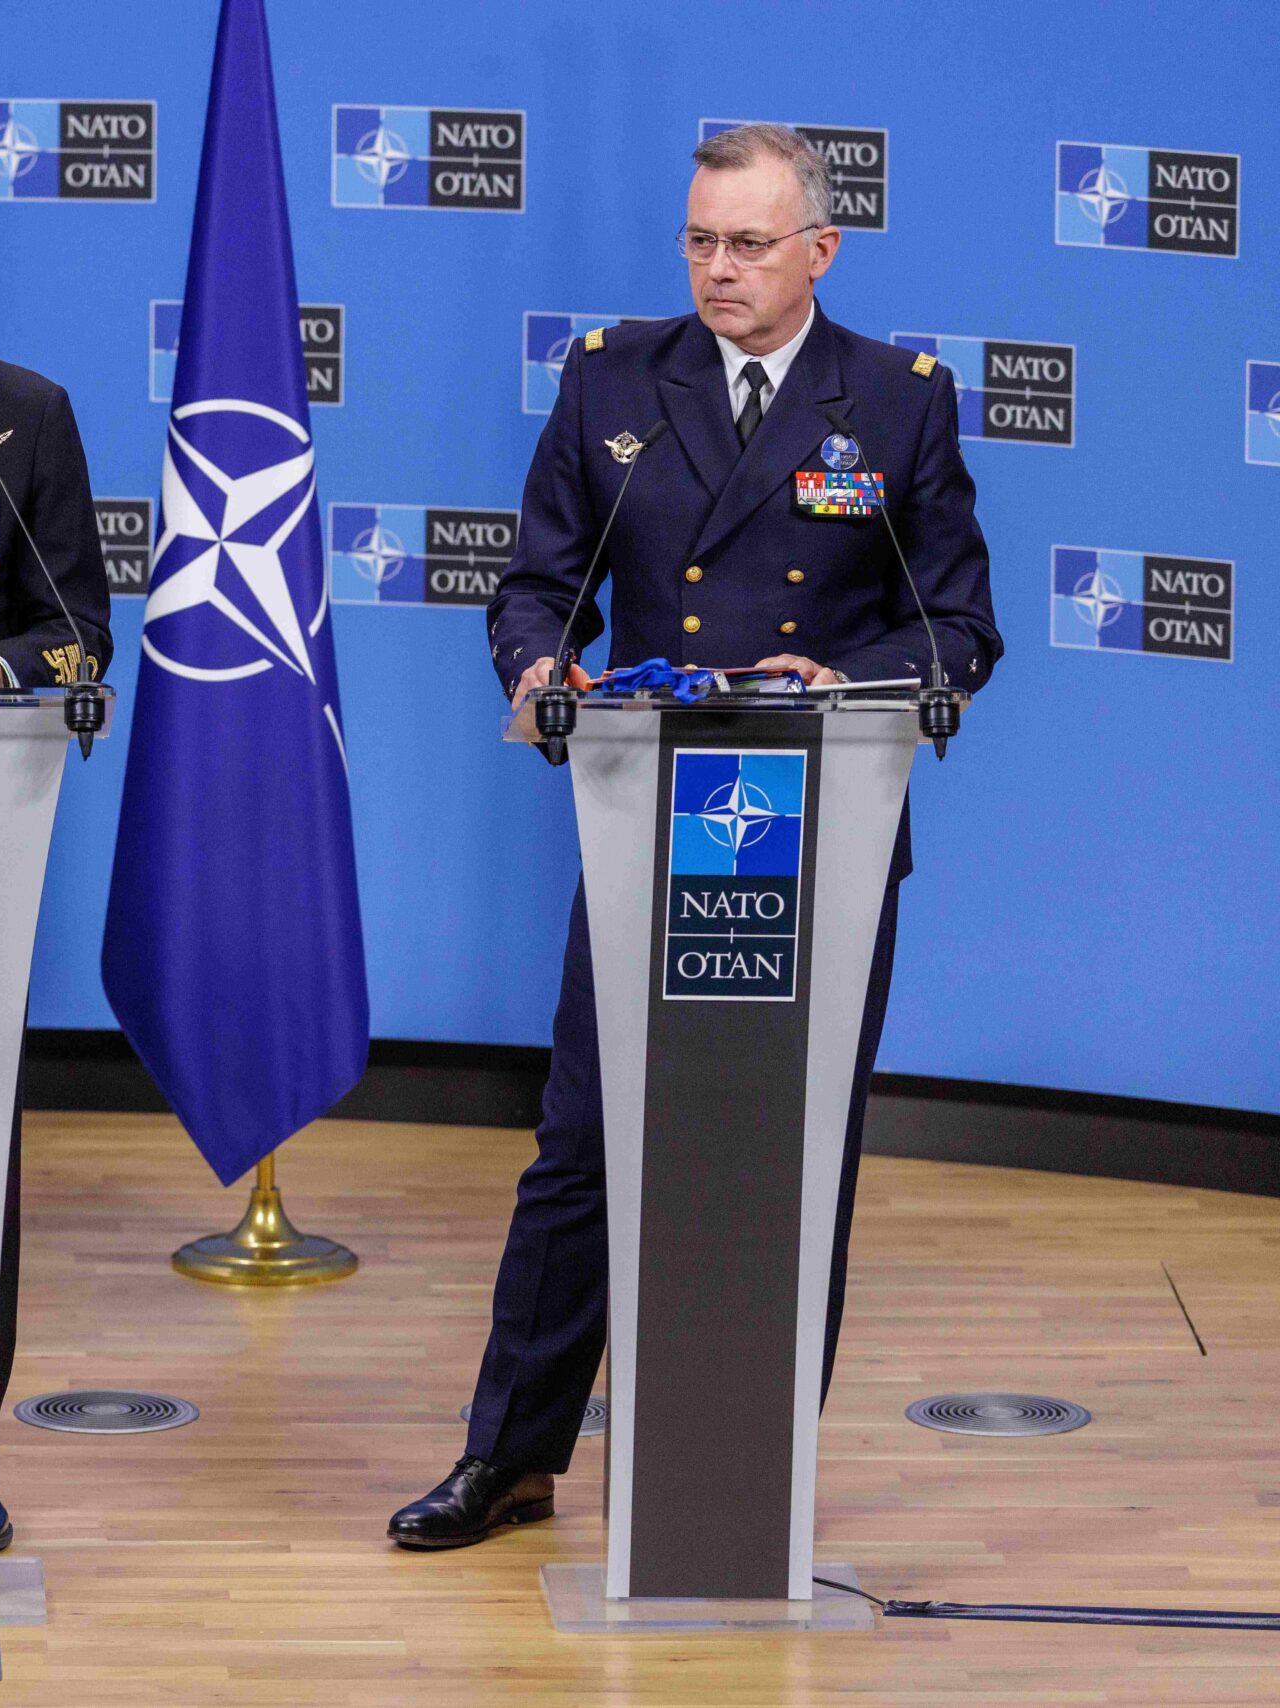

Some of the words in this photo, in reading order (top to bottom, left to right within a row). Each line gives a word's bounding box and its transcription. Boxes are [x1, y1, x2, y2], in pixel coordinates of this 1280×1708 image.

[67, 113, 147, 140] NATO
[438, 121, 516, 149] NATO
[65, 161, 146, 189] OTAN
[435, 170, 515, 198] OTAN
[1157, 164, 1231, 193] NATO
[1155, 213, 1230, 242] OTAN
[299, 318, 335, 343] TO
[991, 353, 1066, 382] NATO
[989, 403, 1065, 432] OTAN
[432, 521, 512, 548] NATO
[104, 559, 143, 583] AN
[1151, 568, 1225, 598] NATO
[1149, 617, 1224, 648] OTAN
[680, 891, 785, 919] NATO
[677, 951, 783, 980] OTAN
